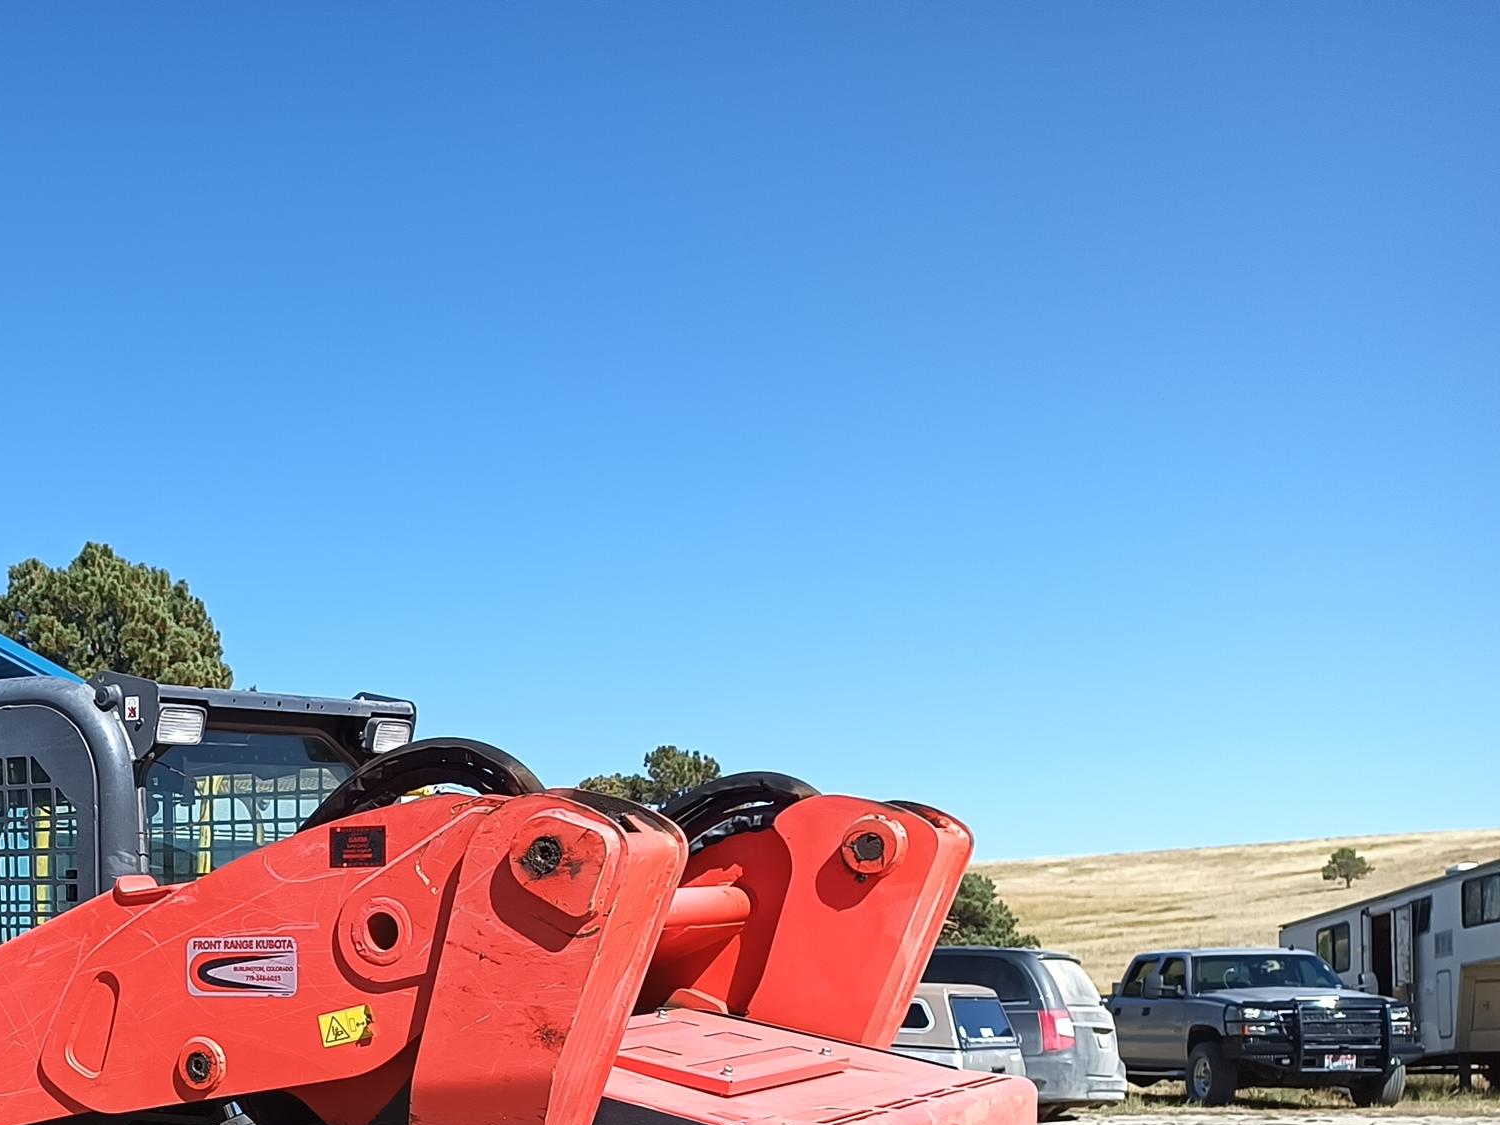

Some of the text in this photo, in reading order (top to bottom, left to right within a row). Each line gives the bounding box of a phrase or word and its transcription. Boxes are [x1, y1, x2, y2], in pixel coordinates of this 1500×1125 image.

[192, 939, 294, 950] FRONT RANGE KUBOTA
